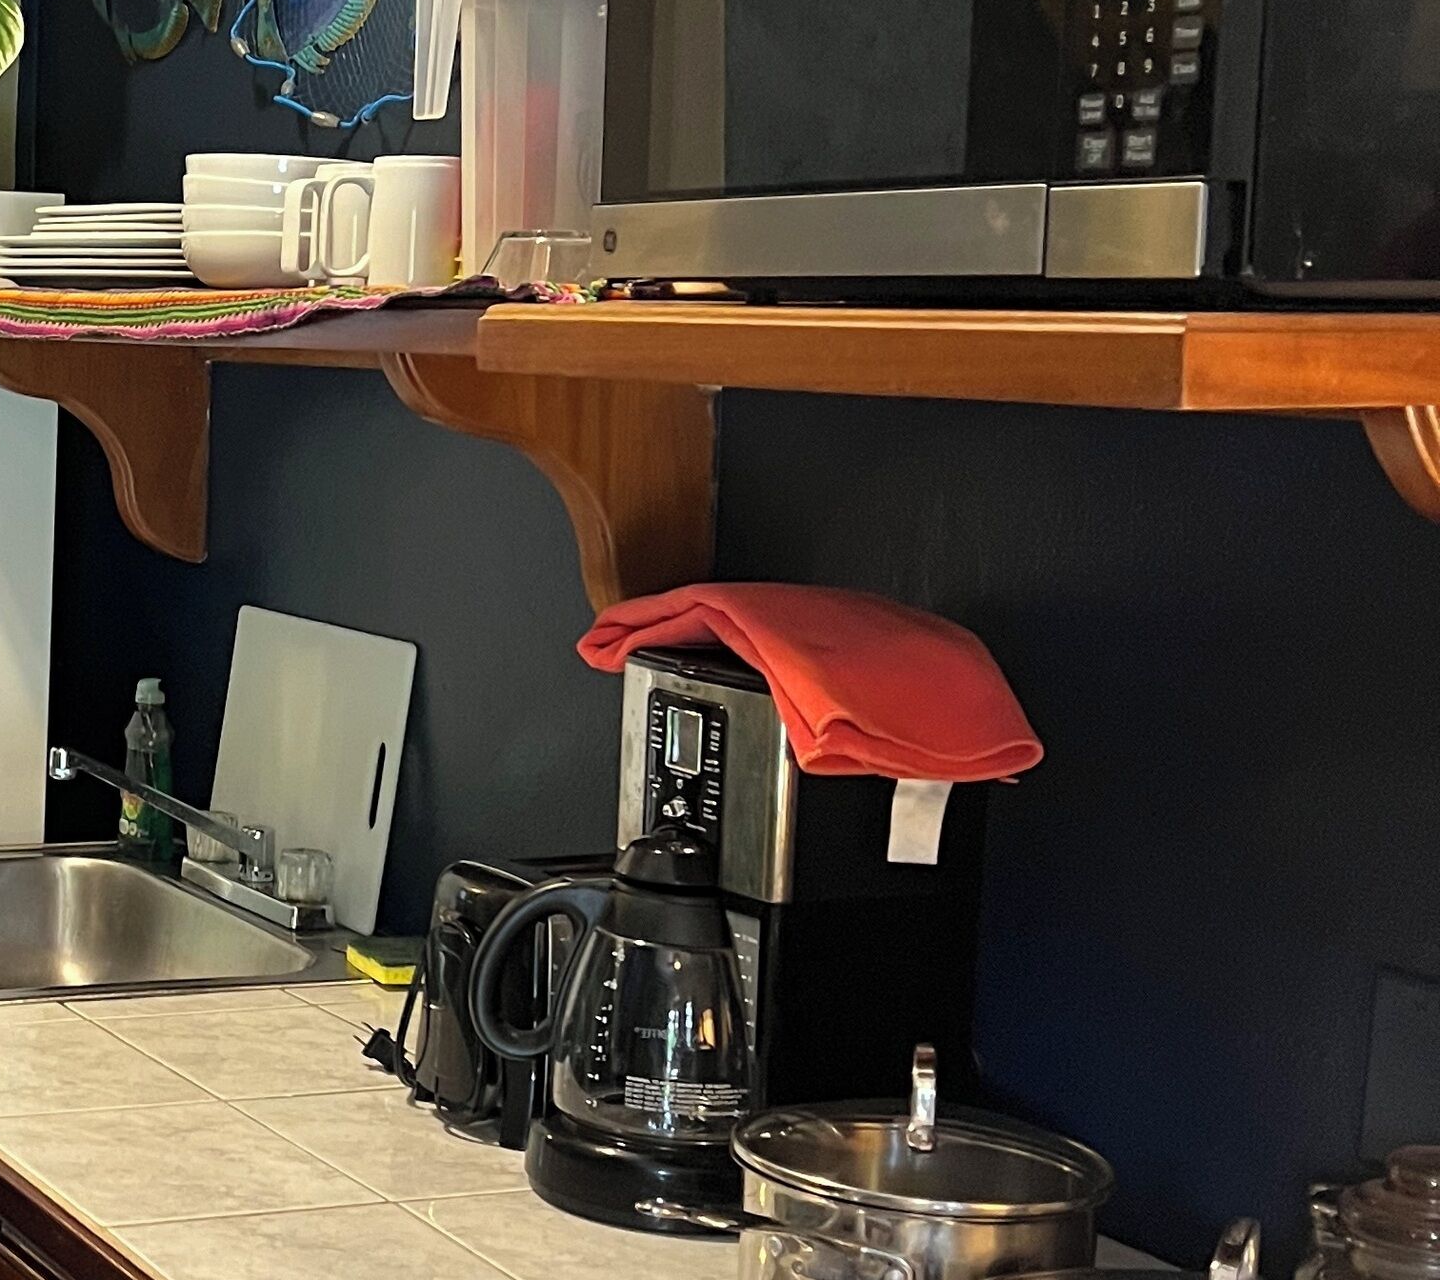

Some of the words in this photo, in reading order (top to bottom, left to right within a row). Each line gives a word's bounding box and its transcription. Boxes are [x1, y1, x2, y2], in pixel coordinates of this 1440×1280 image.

[1093, 4, 1100, 19] 1
[1120, 1, 1129, 15] 2
[1119, 30, 1127, 46] 5
[1145, 27, 1154, 43] 6
